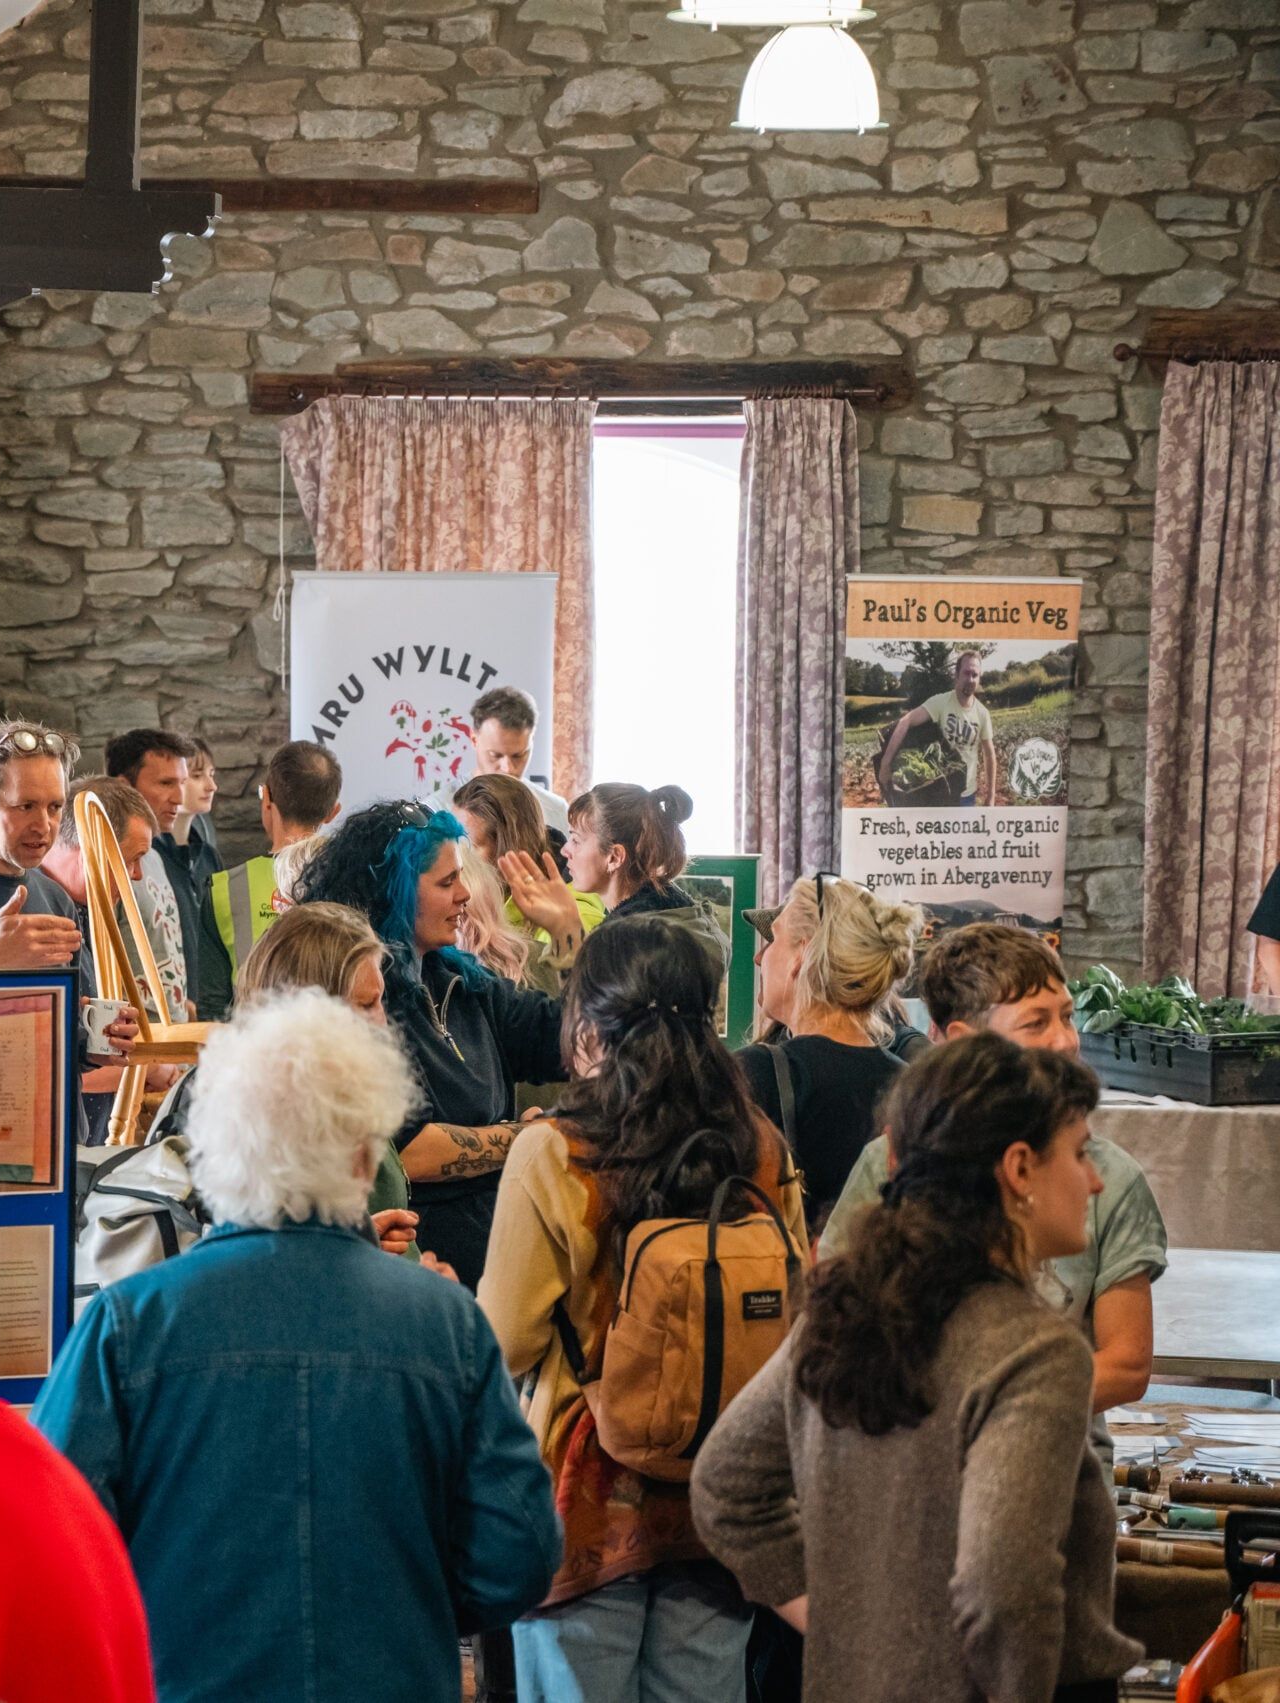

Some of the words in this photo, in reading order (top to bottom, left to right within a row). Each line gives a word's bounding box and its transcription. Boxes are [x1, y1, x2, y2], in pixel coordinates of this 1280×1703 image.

[863, 598, 927, 623] Paul's
[934, 600, 1020, 629] Organic
[1026, 601, 1068, 630] Veg
[371, 645, 498, 690] WYLLT
[859, 816, 911, 838] Fresh,
[915, 816, 990, 837] seasonal,
[996, 816, 1059, 837] organic
[878, 841, 962, 865] vegetables
[968, 841, 997, 859] and
[1002, 841, 1040, 858] fruit
[867, 870, 916, 891] grown
[921, 868, 937, 885] in
[942, 866, 1052, 888] Abergavenny
